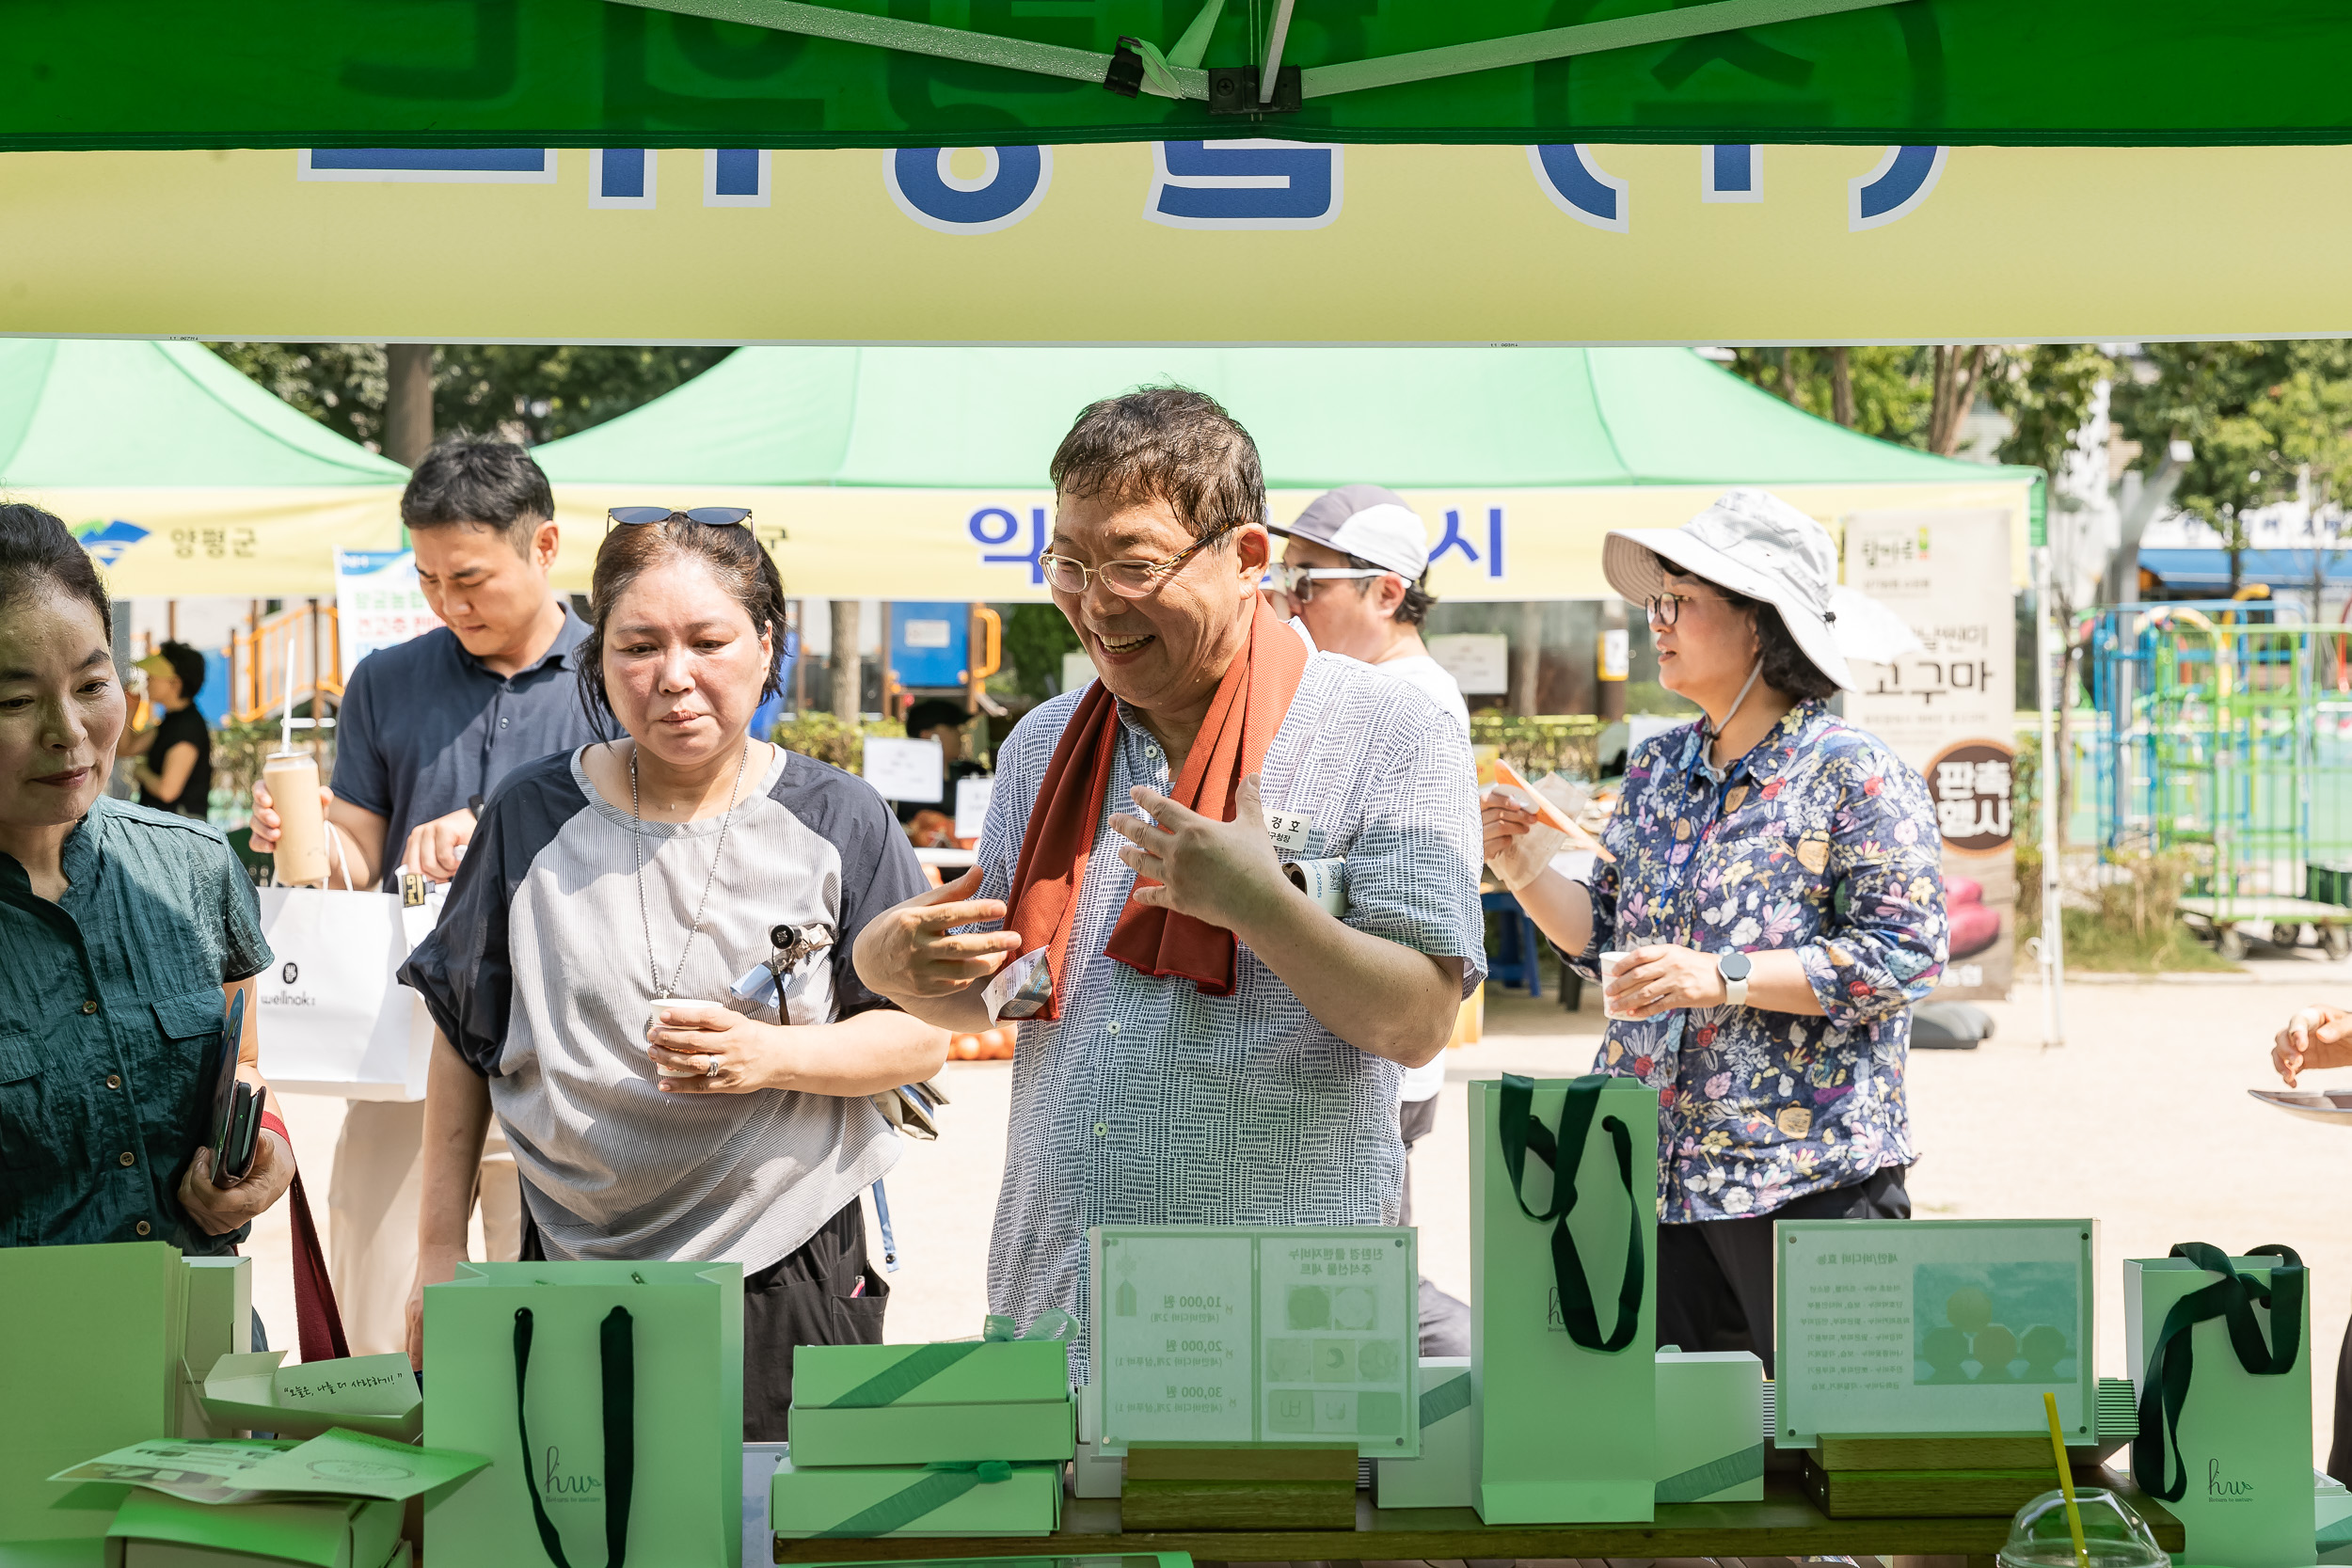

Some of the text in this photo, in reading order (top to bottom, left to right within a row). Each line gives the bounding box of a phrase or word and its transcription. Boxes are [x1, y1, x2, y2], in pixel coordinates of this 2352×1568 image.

[170, 528, 256, 559] 양평군
[1865, 659, 1994, 704] 고구마
[1936, 760, 2011, 800] 판촉
[1936, 800, 2012, 837] 행사
[1268, 831, 1292, 844] 구청장
[317, 1381, 336, 1395] 나를
[337, 1381, 347, 1390] 더
